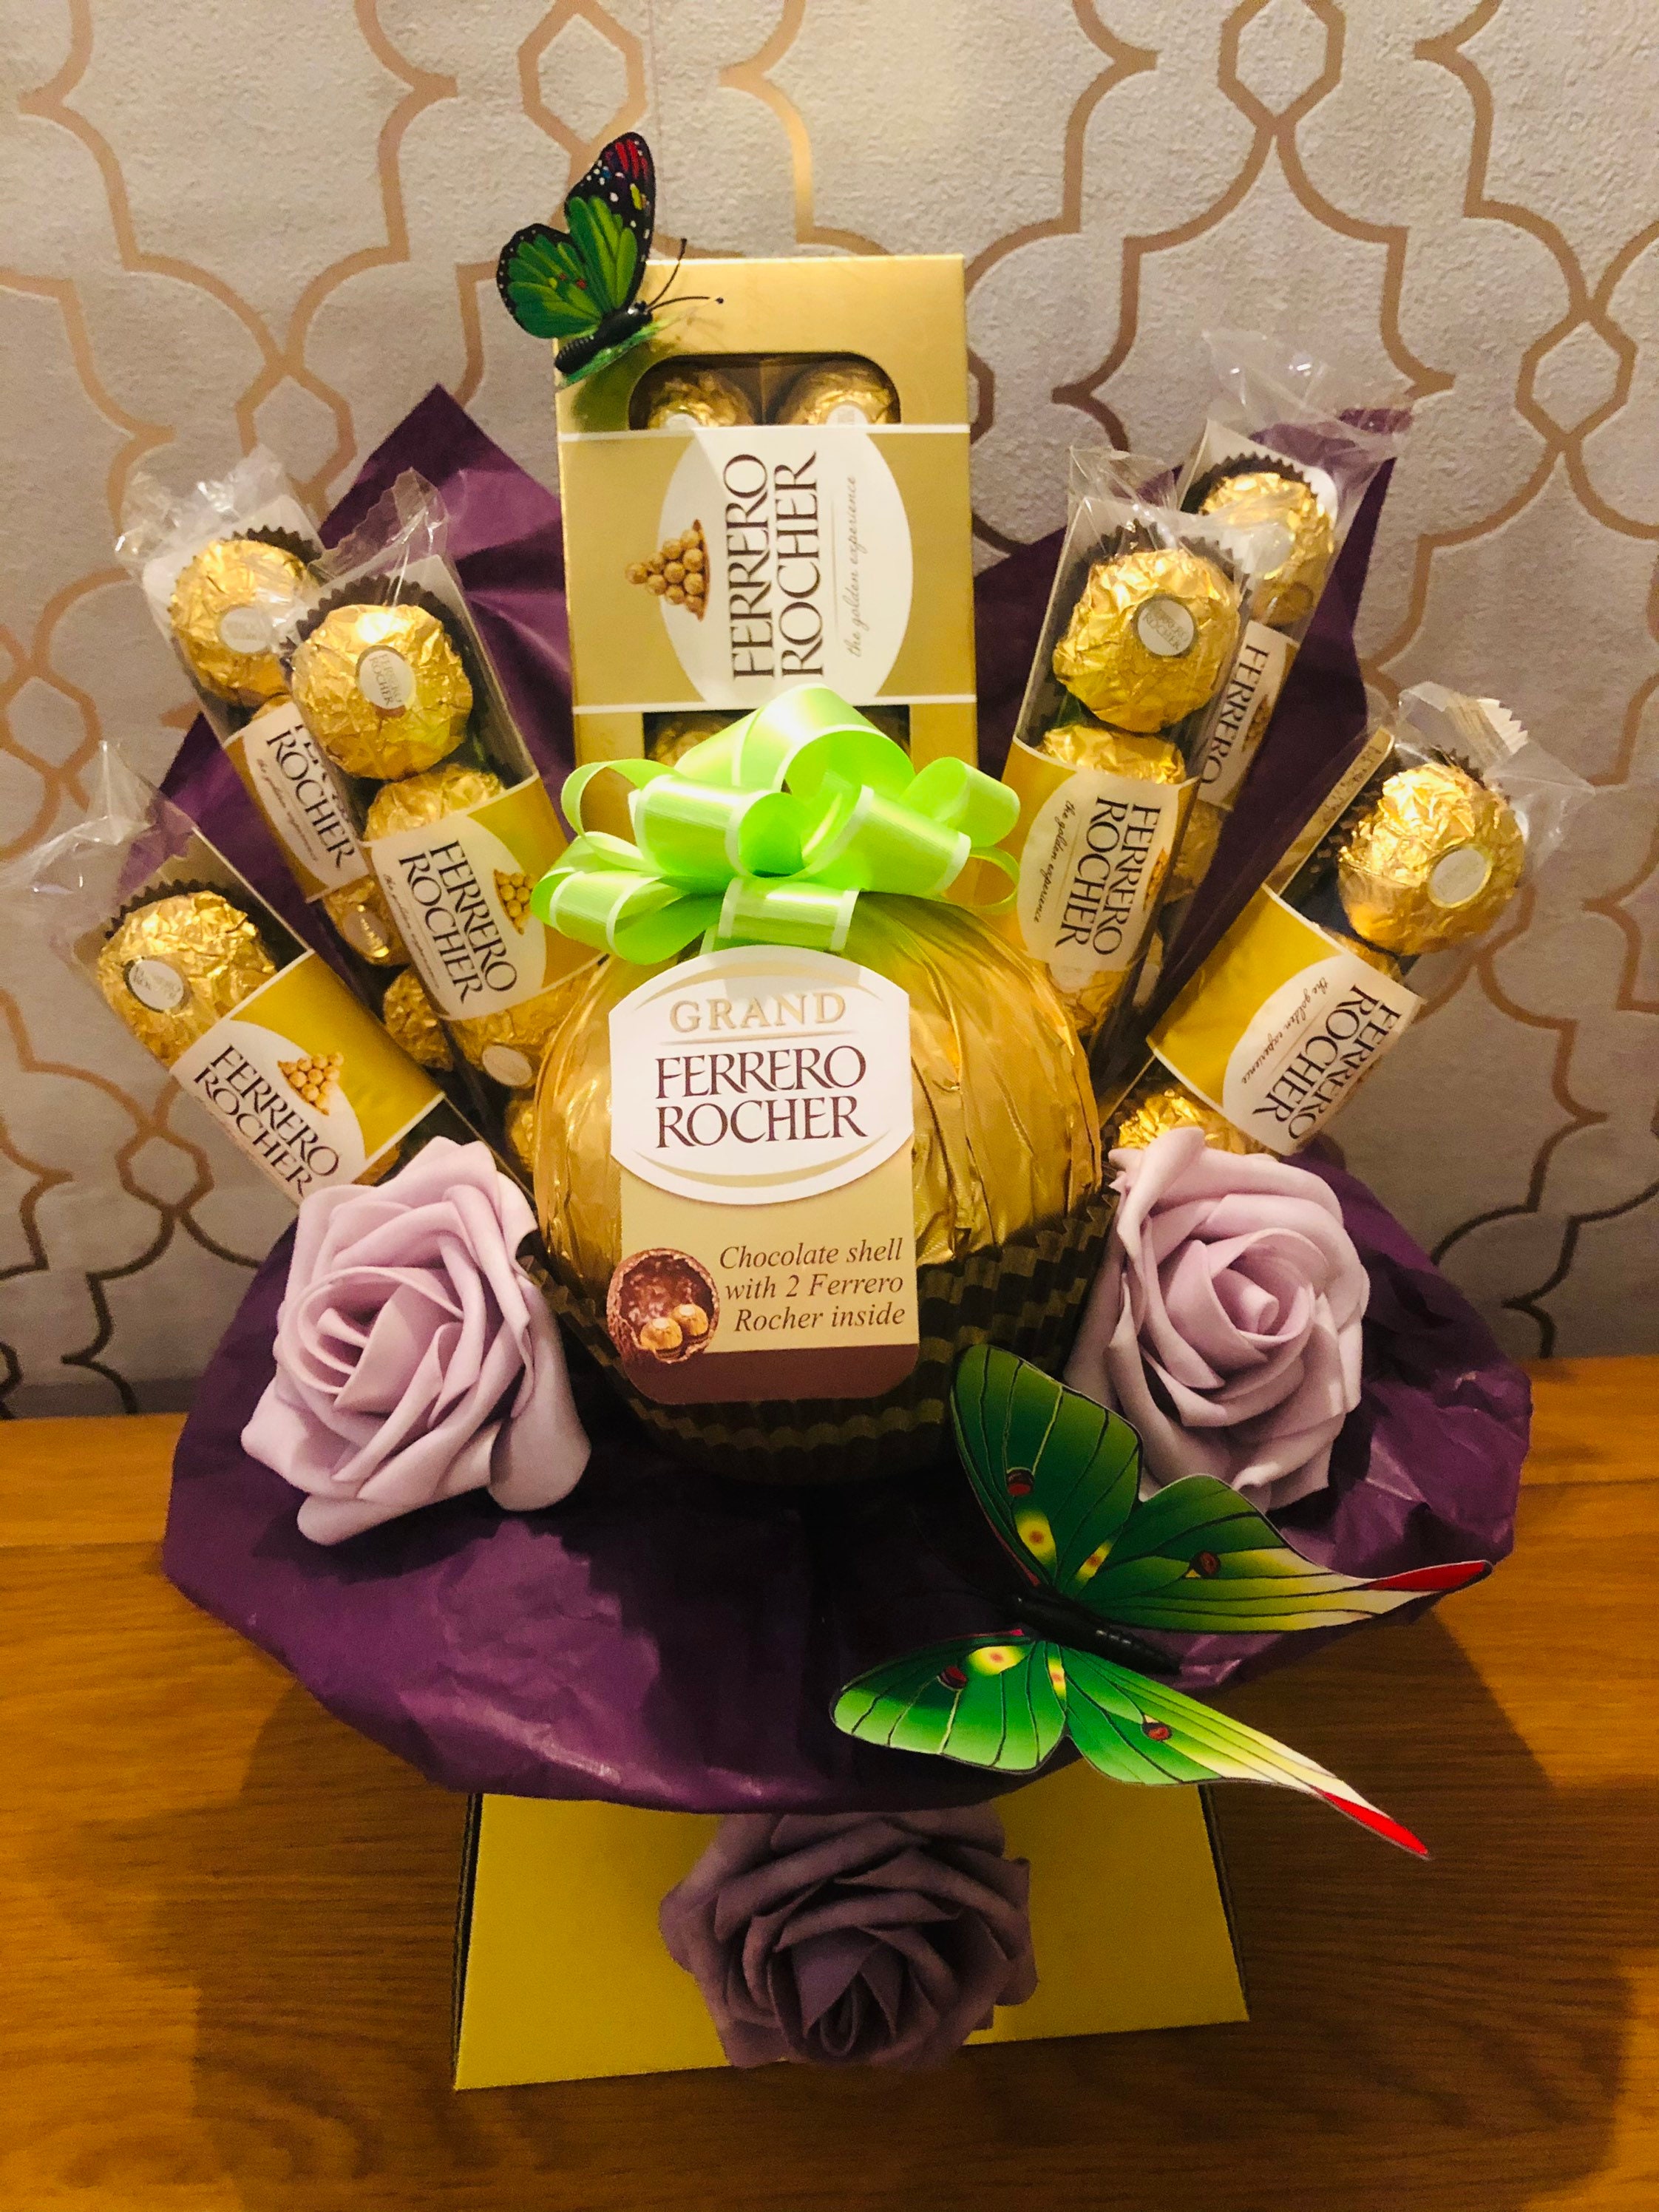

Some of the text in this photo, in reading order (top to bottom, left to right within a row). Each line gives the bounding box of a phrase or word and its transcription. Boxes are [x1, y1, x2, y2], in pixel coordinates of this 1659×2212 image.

[723, 453, 776, 681] FERRERO
[773, 450, 825, 678] ROCHER
[843, 475, 869, 657] the golden experience
[1201, 645, 1269, 784] FERRERO
[266, 730, 356, 869] ROCHER
[1034, 800, 1076, 923] the golden experience
[398, 852, 484, 1005] ROCHER
[430, 839, 518, 992] FERRERO
[1055, 796, 1129, 949] ROCHER
[1093, 804, 1162, 955] FERRERO
[655, 1045, 866, 1099] FERRERO
[669, 991, 847, 1034] GRAND
[1241, 977, 1329, 1085] the golden experience
[1252, 984, 1380, 1123] ROCHER
[1288, 1001, 1402, 1139] FERRERO
[193, 1067, 313, 1198] ROCHER
[210, 1044, 339, 1177] FERRERO
[655, 1096, 869, 1149] ROCHER
[719, 1237, 903, 1269] Chocolate shell
[725, 1273, 904, 1300] with 2 Ferrero
[734, 1301, 906, 1332] Rocher inside
